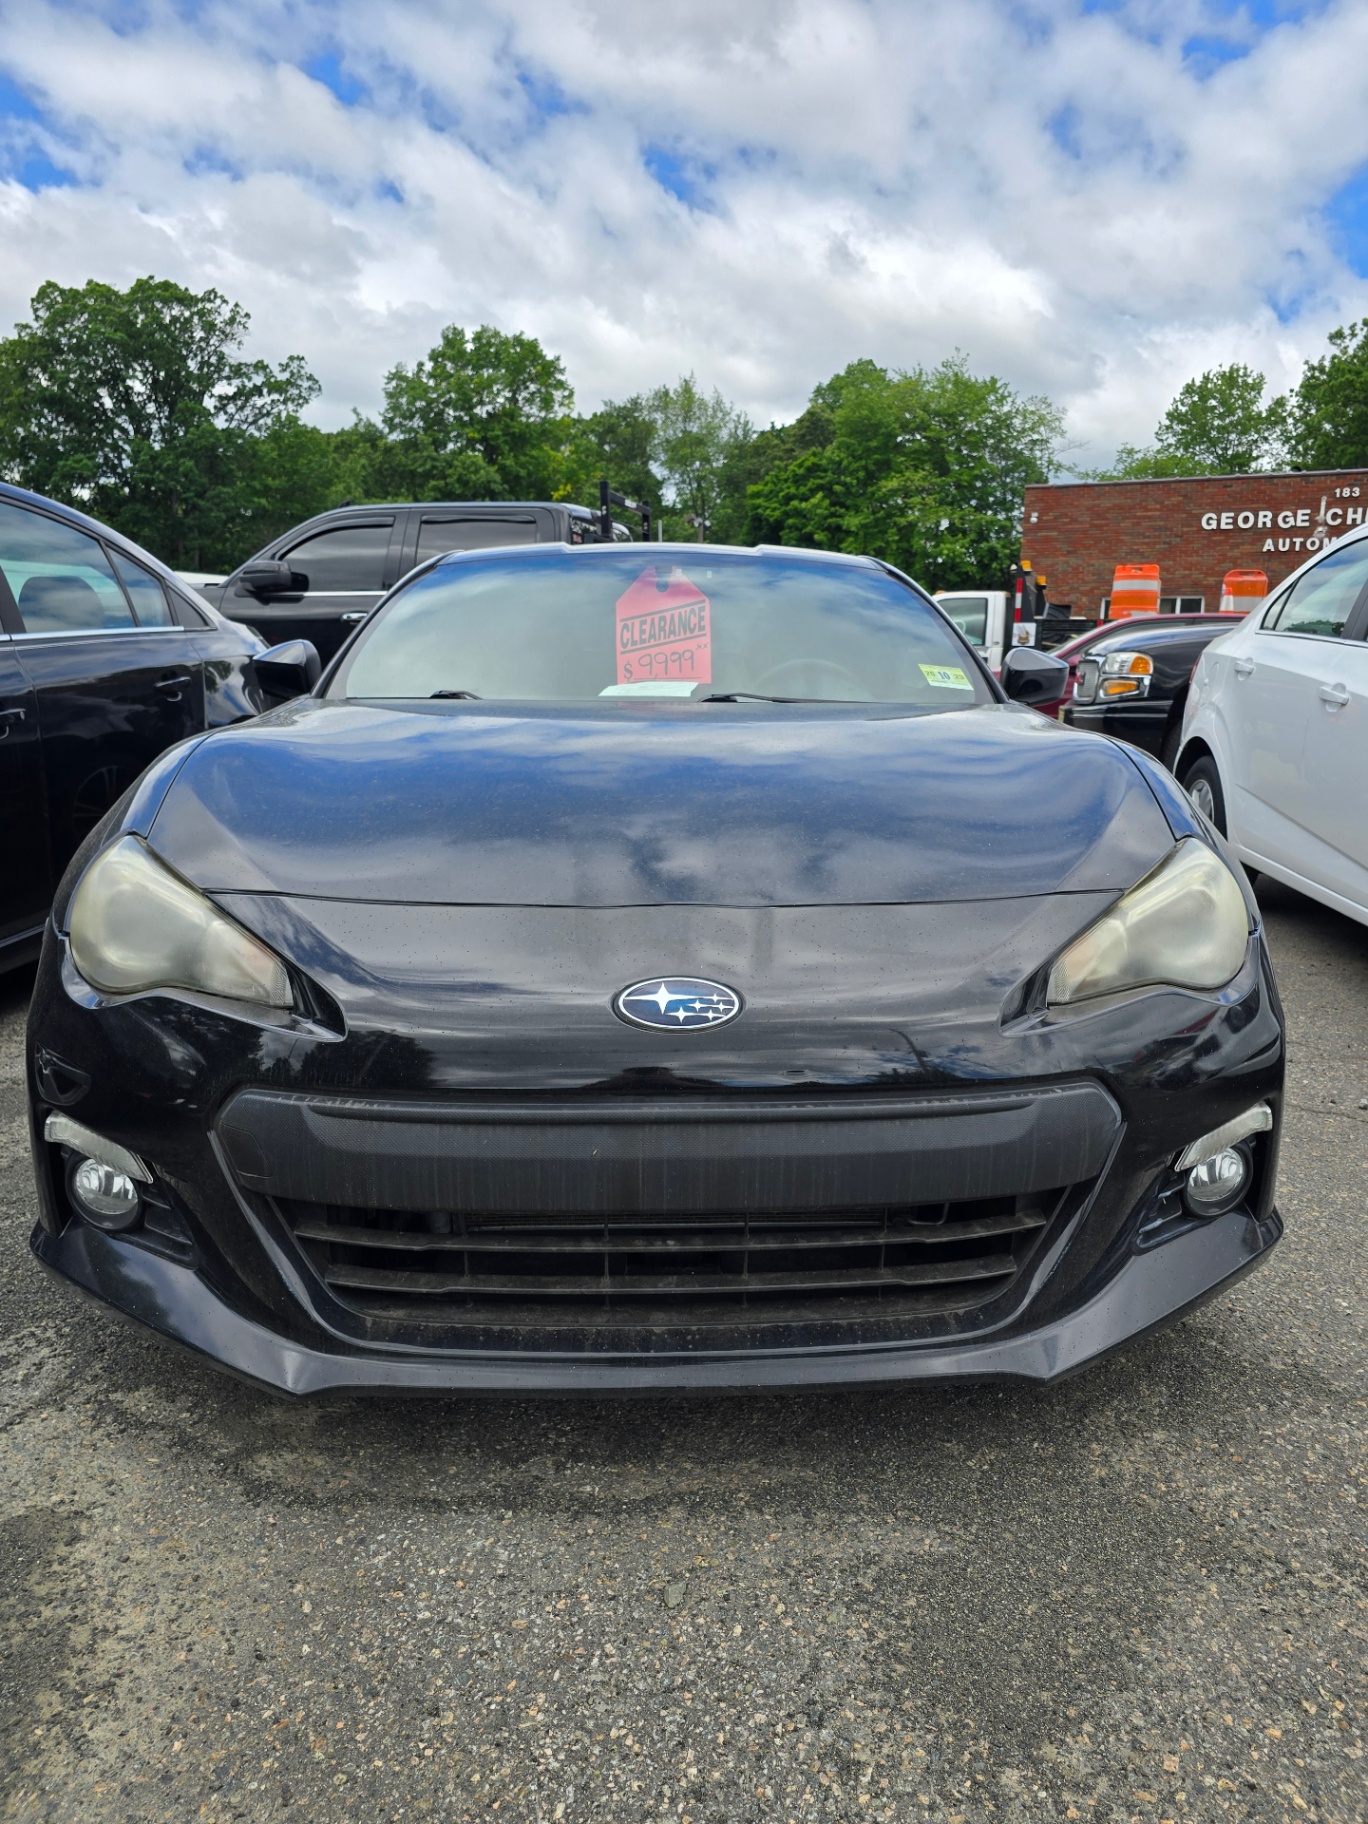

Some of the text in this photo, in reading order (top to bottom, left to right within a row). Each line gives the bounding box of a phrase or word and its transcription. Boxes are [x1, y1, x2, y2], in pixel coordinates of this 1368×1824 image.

[1334, 487, 1360, 498] 183
[1201, 509, 1311, 530] GEORGE
[620, 605, 706, 649] CLEARANCE
[938, 671, 950, 680] 10
